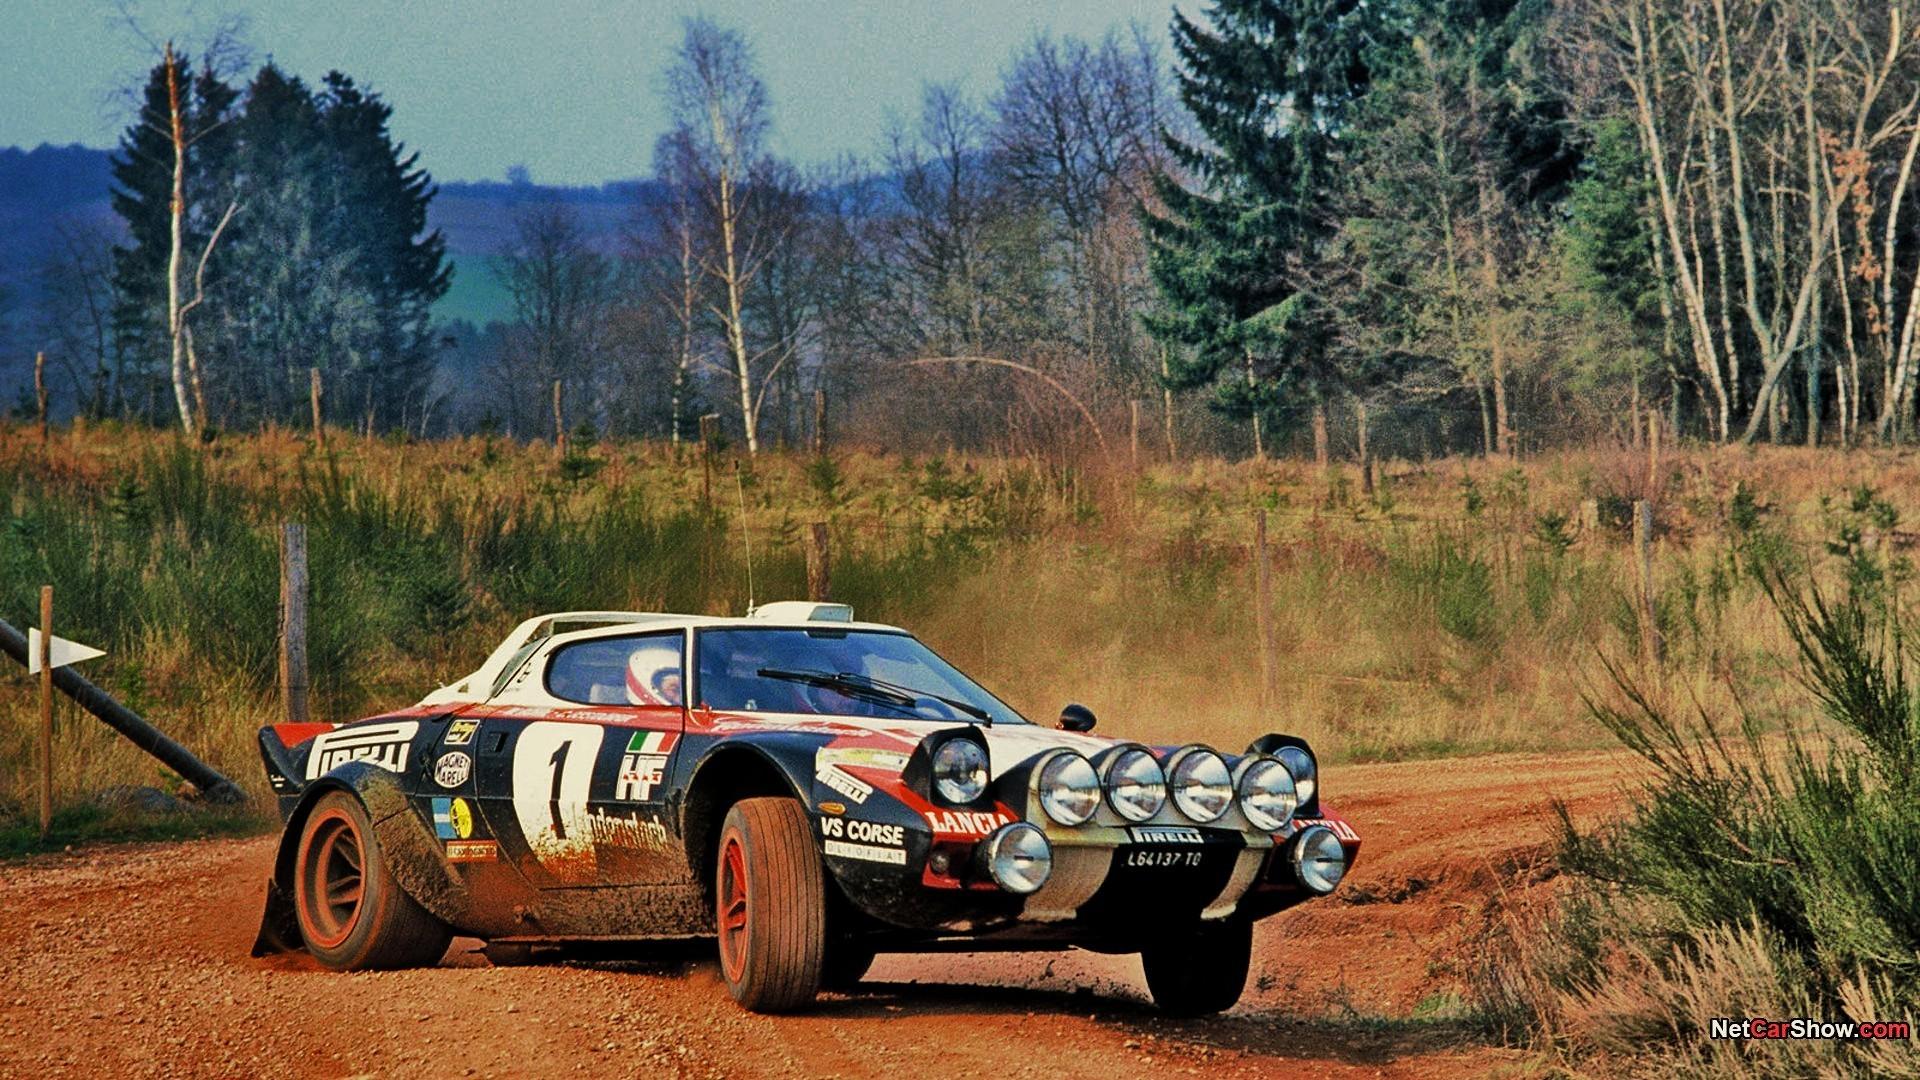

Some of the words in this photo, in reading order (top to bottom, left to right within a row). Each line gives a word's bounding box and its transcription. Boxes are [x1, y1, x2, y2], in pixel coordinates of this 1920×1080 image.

[305, 721, 419, 780] PIRELLI
[437, 755, 469, 774] MAGNET
[435, 766, 468, 787] MARELLI
[549, 740, 572, 840] 1
[615, 756, 668, 800] HF
[815, 763, 873, 805] PIRELLI
[821, 817, 844, 838] VS
[847, 821, 904, 846] CORSE
[1131, 827, 1204, 844] PIRELLI
[1185, 851, 1203, 867] TO
